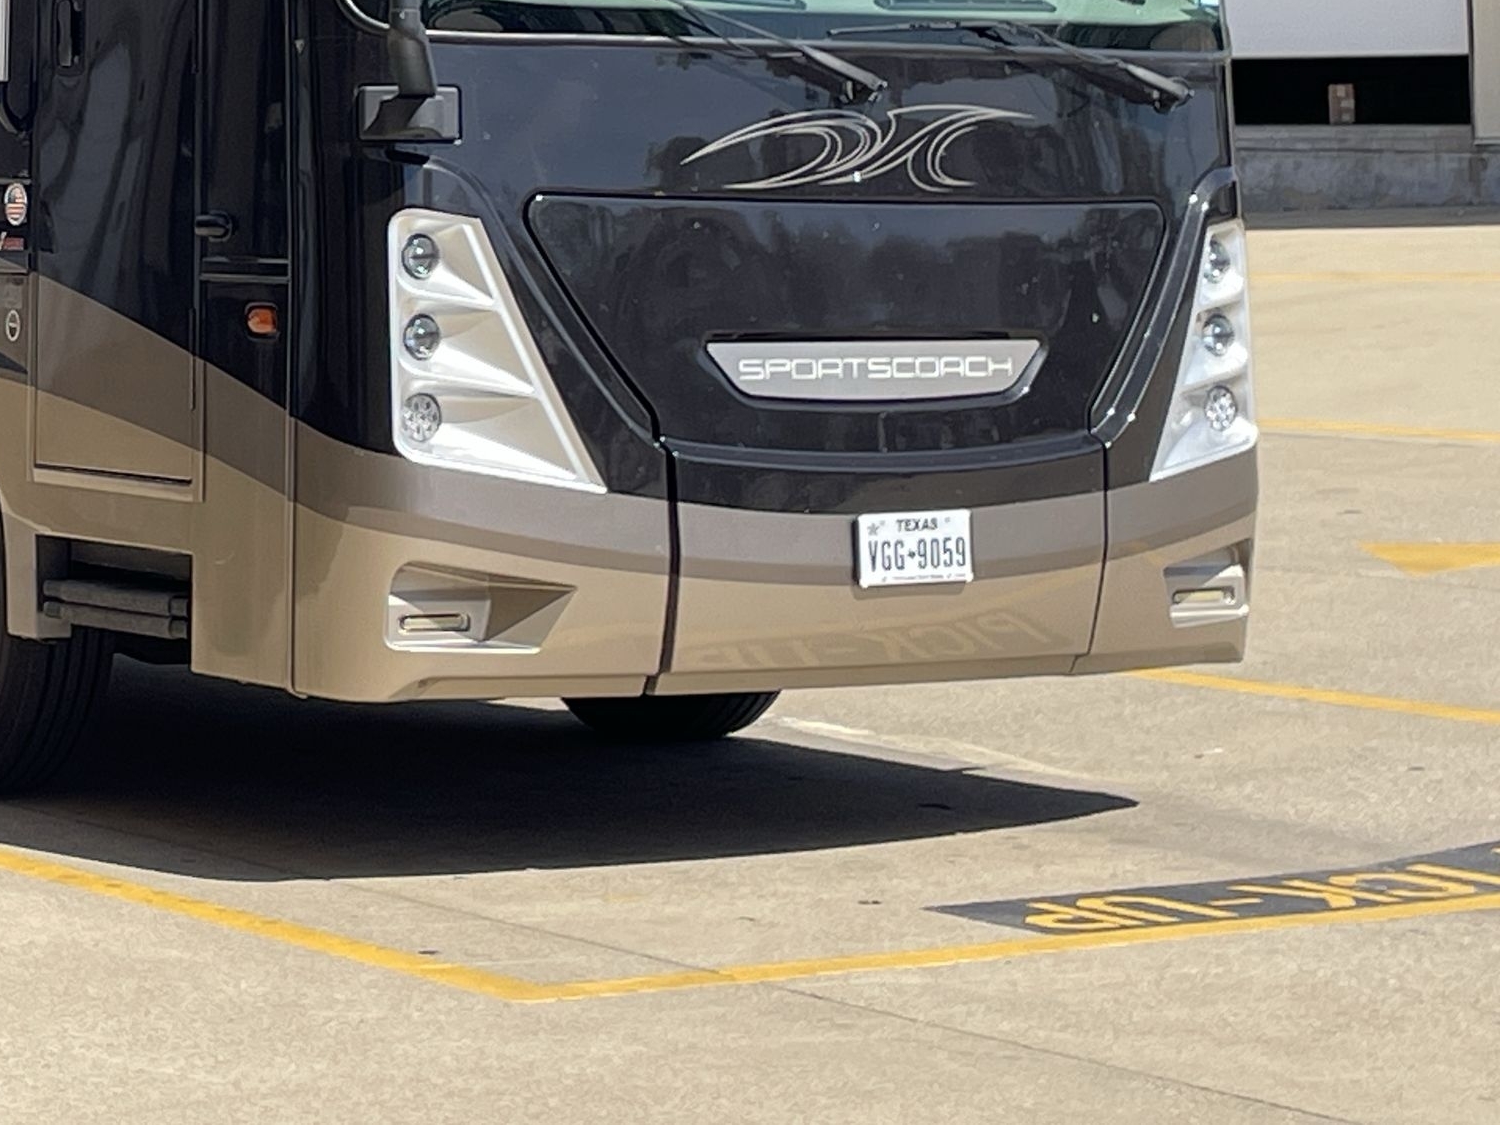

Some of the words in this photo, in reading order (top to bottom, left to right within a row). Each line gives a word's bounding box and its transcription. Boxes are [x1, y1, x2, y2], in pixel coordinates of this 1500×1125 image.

[737, 355, 1014, 381] SPORTSCOACH
[896, 517, 938, 532] TEXAS
[1024, 847, 1500, 930] ICK-UP
